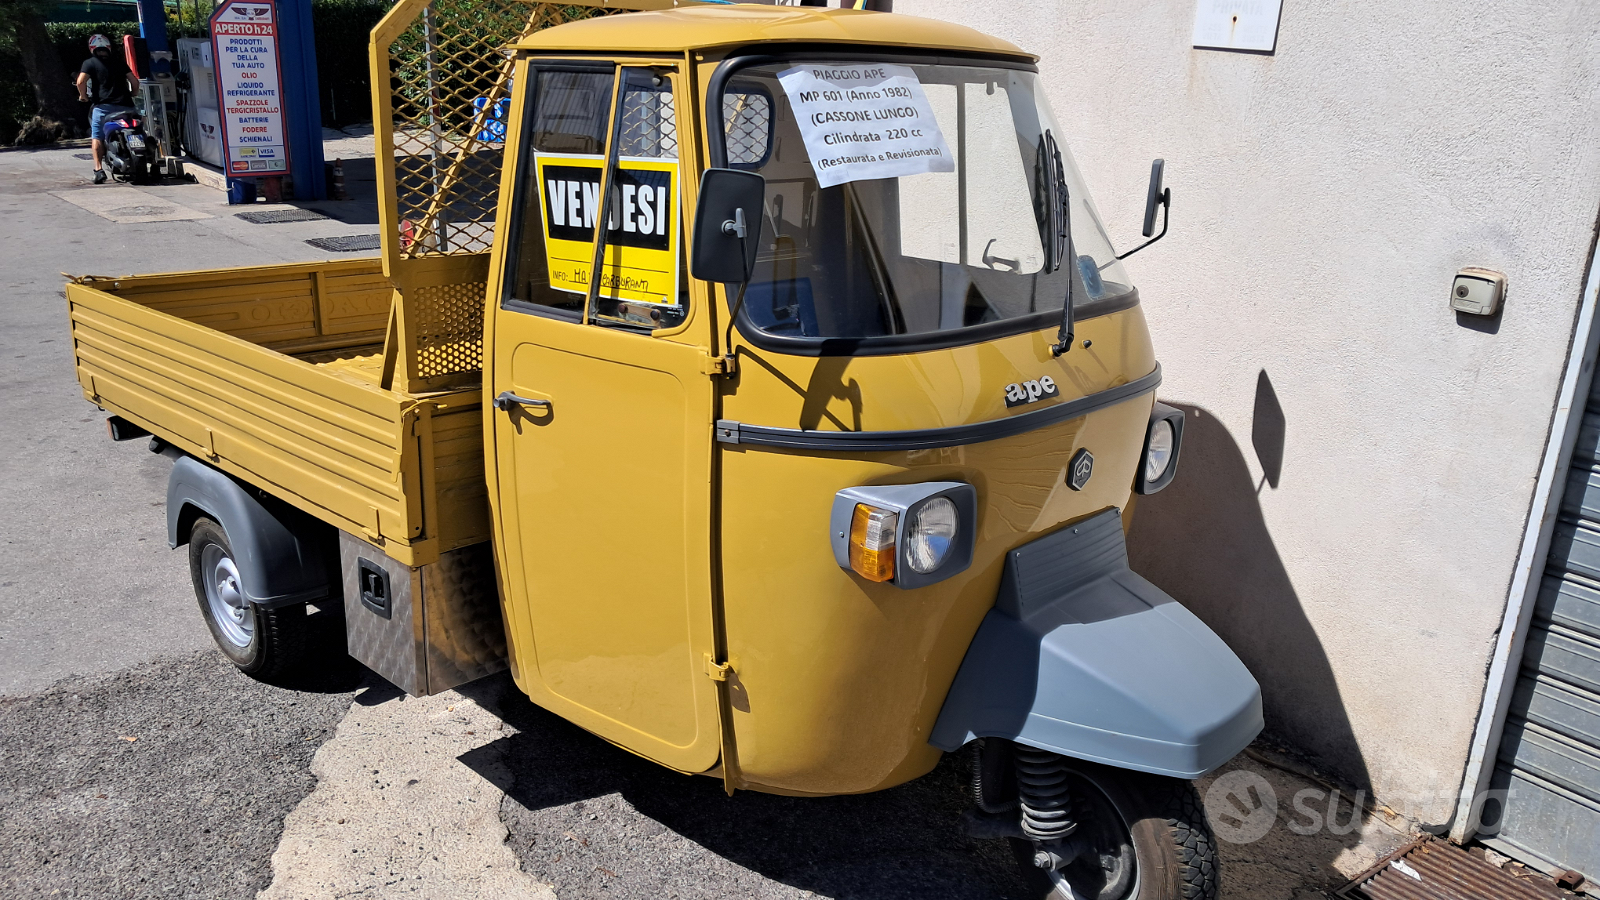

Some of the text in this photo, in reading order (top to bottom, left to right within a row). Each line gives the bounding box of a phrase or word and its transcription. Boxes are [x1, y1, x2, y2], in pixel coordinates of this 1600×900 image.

[215, 24, 273, 34] APERTO h 24
[813, 68, 886, 80] PIAGGIO APE
[800, 87, 913, 103] MP 601 (Anno 1982)
[811, 106, 919, 127] (CASSONE LUNGO)
[824, 128, 923, 145] Cilindrata 220 cc
[817, 154, 876, 171] (Restaurata
[887, 147, 943, 160] Revisionata)
[553, 270, 568, 281] INFO:
[1004, 375, 1056, 404] ape
